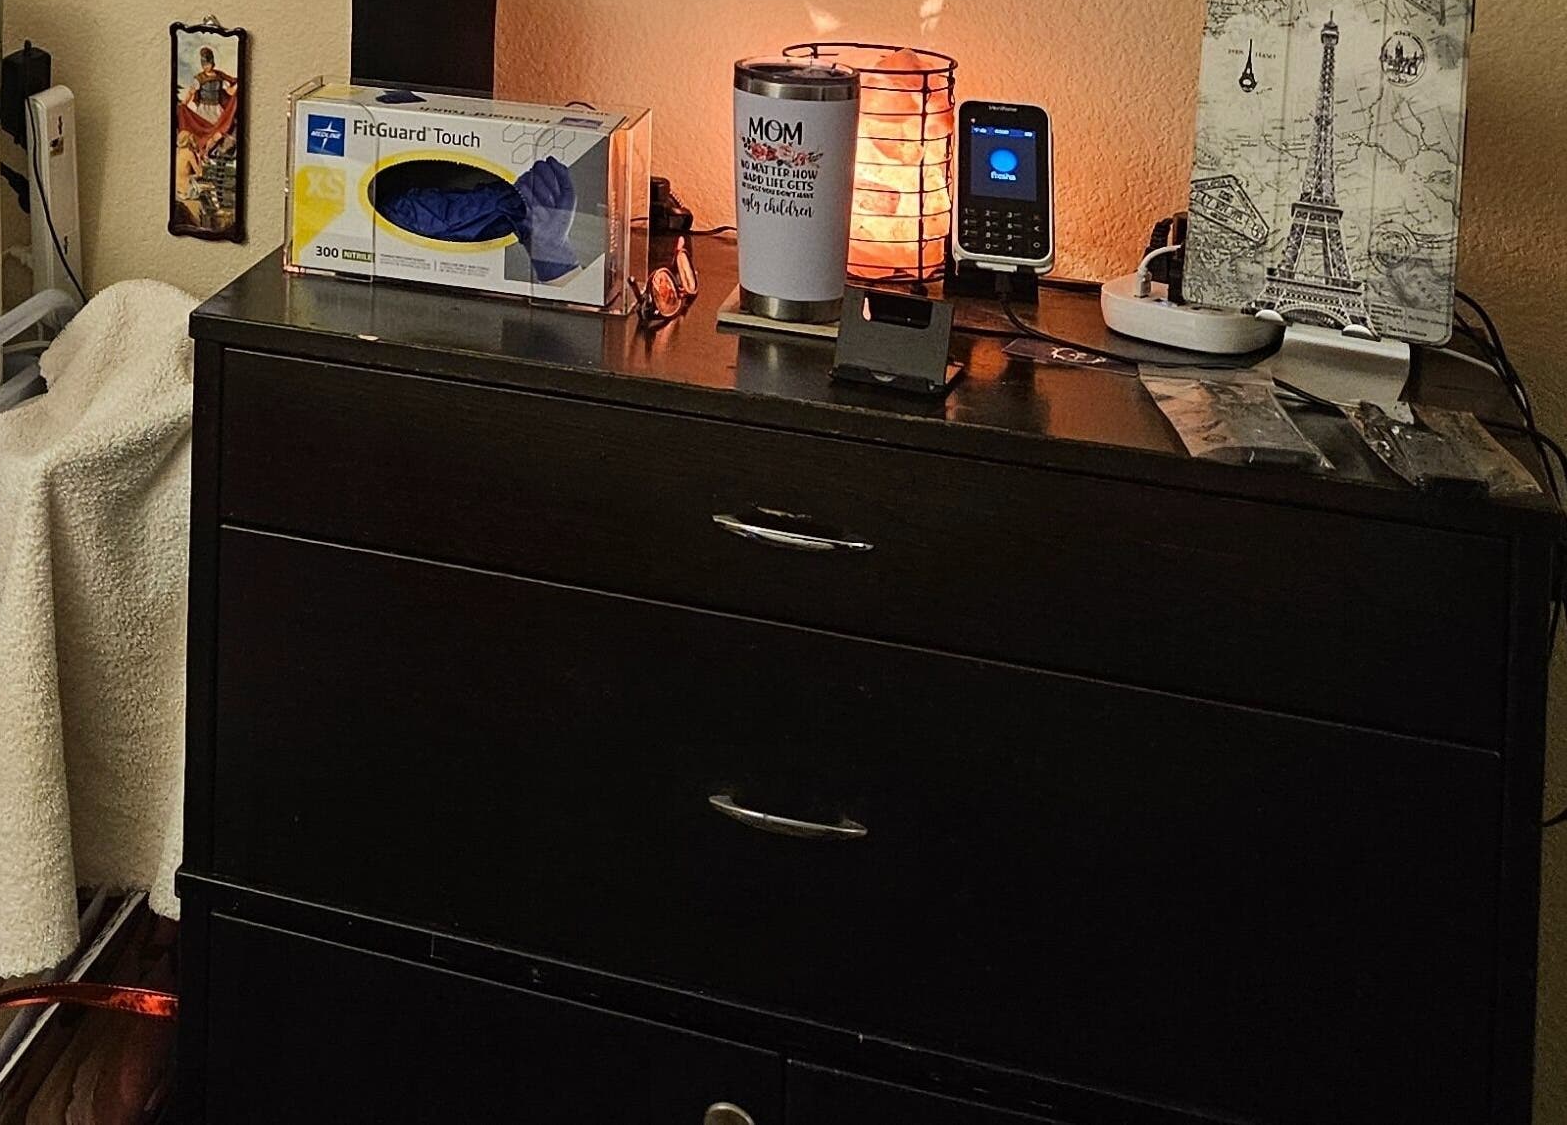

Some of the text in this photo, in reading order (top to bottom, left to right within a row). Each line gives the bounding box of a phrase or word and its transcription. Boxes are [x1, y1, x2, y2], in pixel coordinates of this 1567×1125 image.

[352, 119, 481, 148] FitGuard Touch
[748, 116, 804, 146] MOM
[751, 162, 790, 178] MATTER
[792, 169, 819, 180] HOW
[766, 176, 785, 189] LIFE
[786, 180, 814, 192] GETS
[763, 197, 815, 219] children
[315, 245, 374, 262] 300 NITRILE
